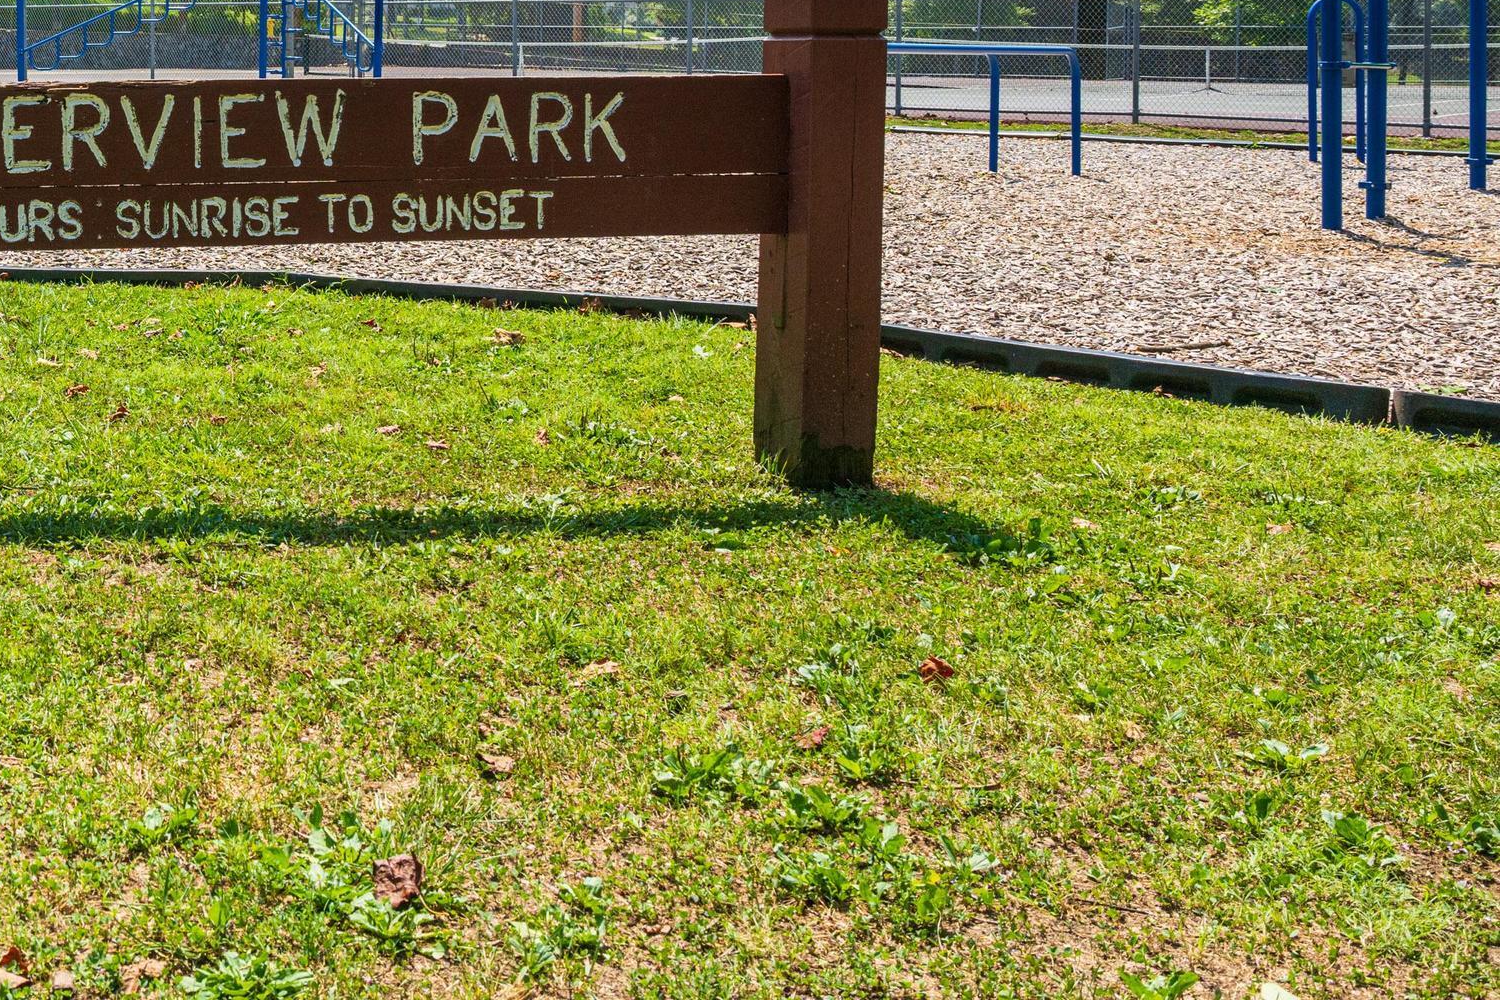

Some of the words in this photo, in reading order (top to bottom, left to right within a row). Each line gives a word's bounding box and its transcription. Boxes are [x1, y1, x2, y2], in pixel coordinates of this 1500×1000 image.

[412, 91, 626, 164] PARK
[115, 196, 300, 239] SUNRISE
[318, 193, 374, 233] TO
[391, 189, 554, 234] SUNSET
